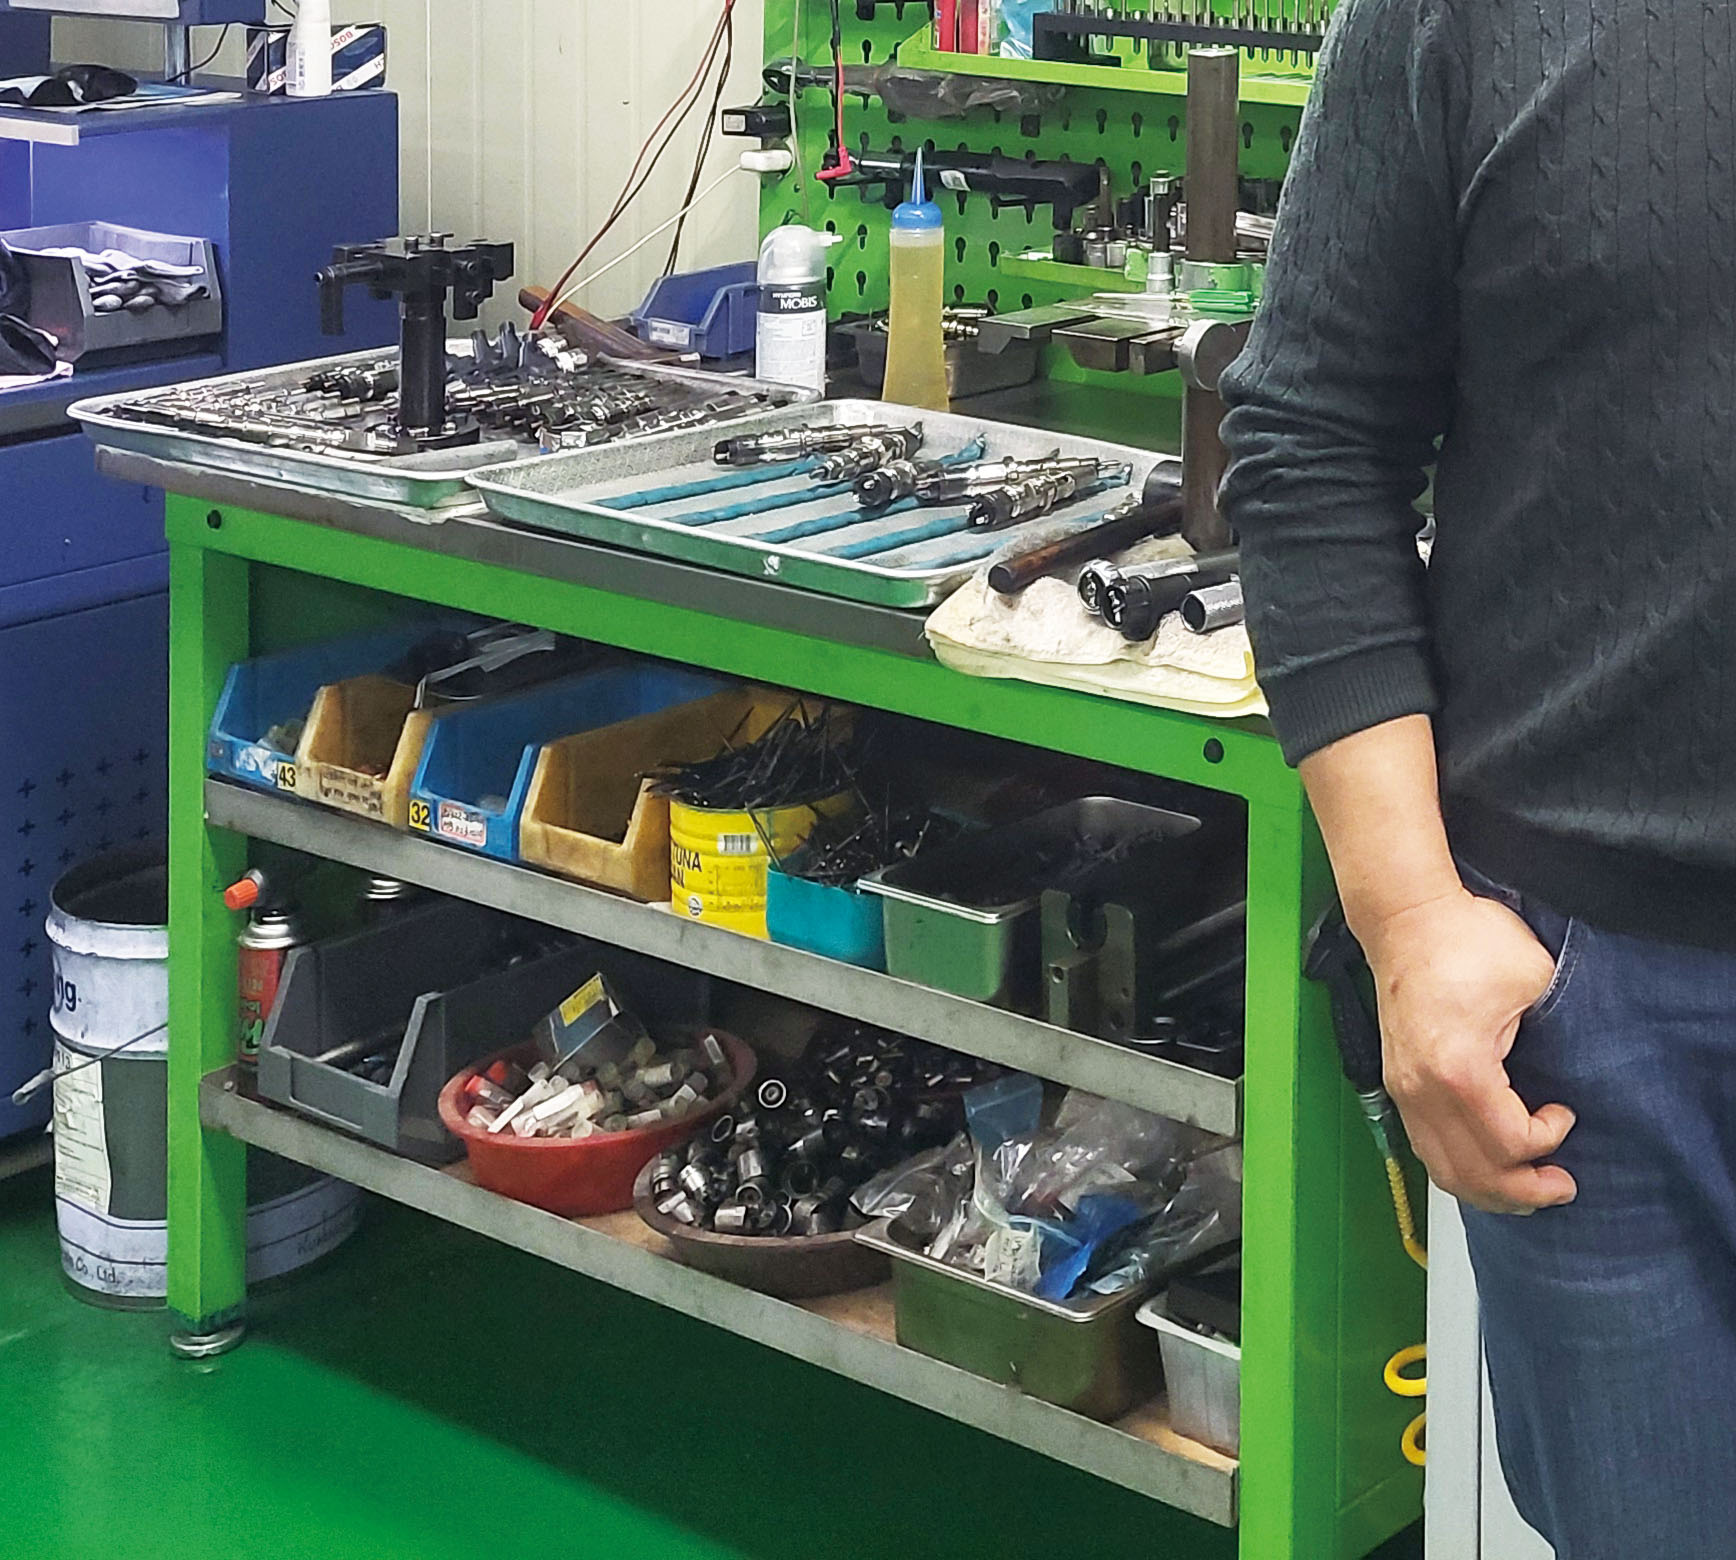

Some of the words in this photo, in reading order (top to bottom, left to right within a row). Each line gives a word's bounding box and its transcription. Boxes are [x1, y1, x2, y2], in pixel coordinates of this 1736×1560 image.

[780, 295, 818, 310] MOBIS
[278, 765, 297, 788] 43
[410, 802, 431, 826] 32
